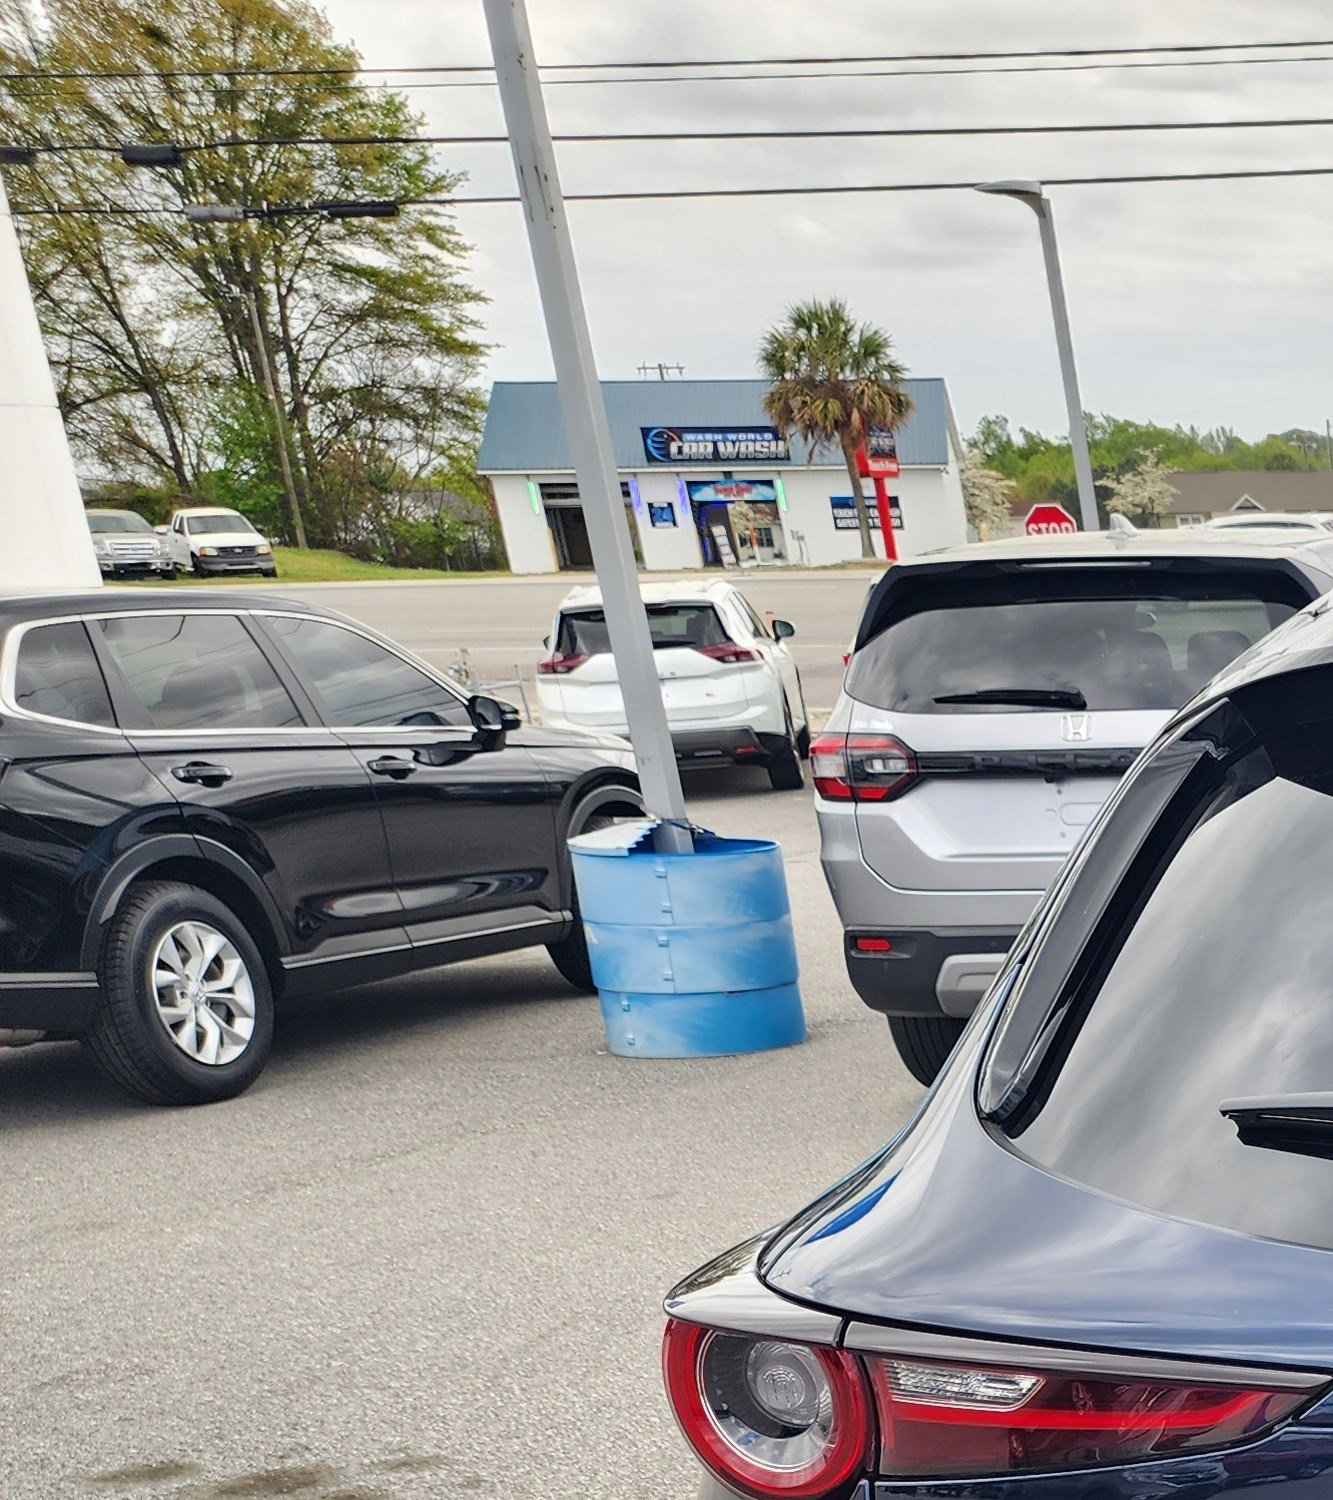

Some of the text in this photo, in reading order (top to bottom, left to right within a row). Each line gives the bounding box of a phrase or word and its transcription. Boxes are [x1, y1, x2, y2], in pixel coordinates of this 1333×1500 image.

[686, 432, 773, 441] WASH WORLD
[669, 440, 785, 460] CAR WASH
[1028, 522, 1072, 535] STOP
